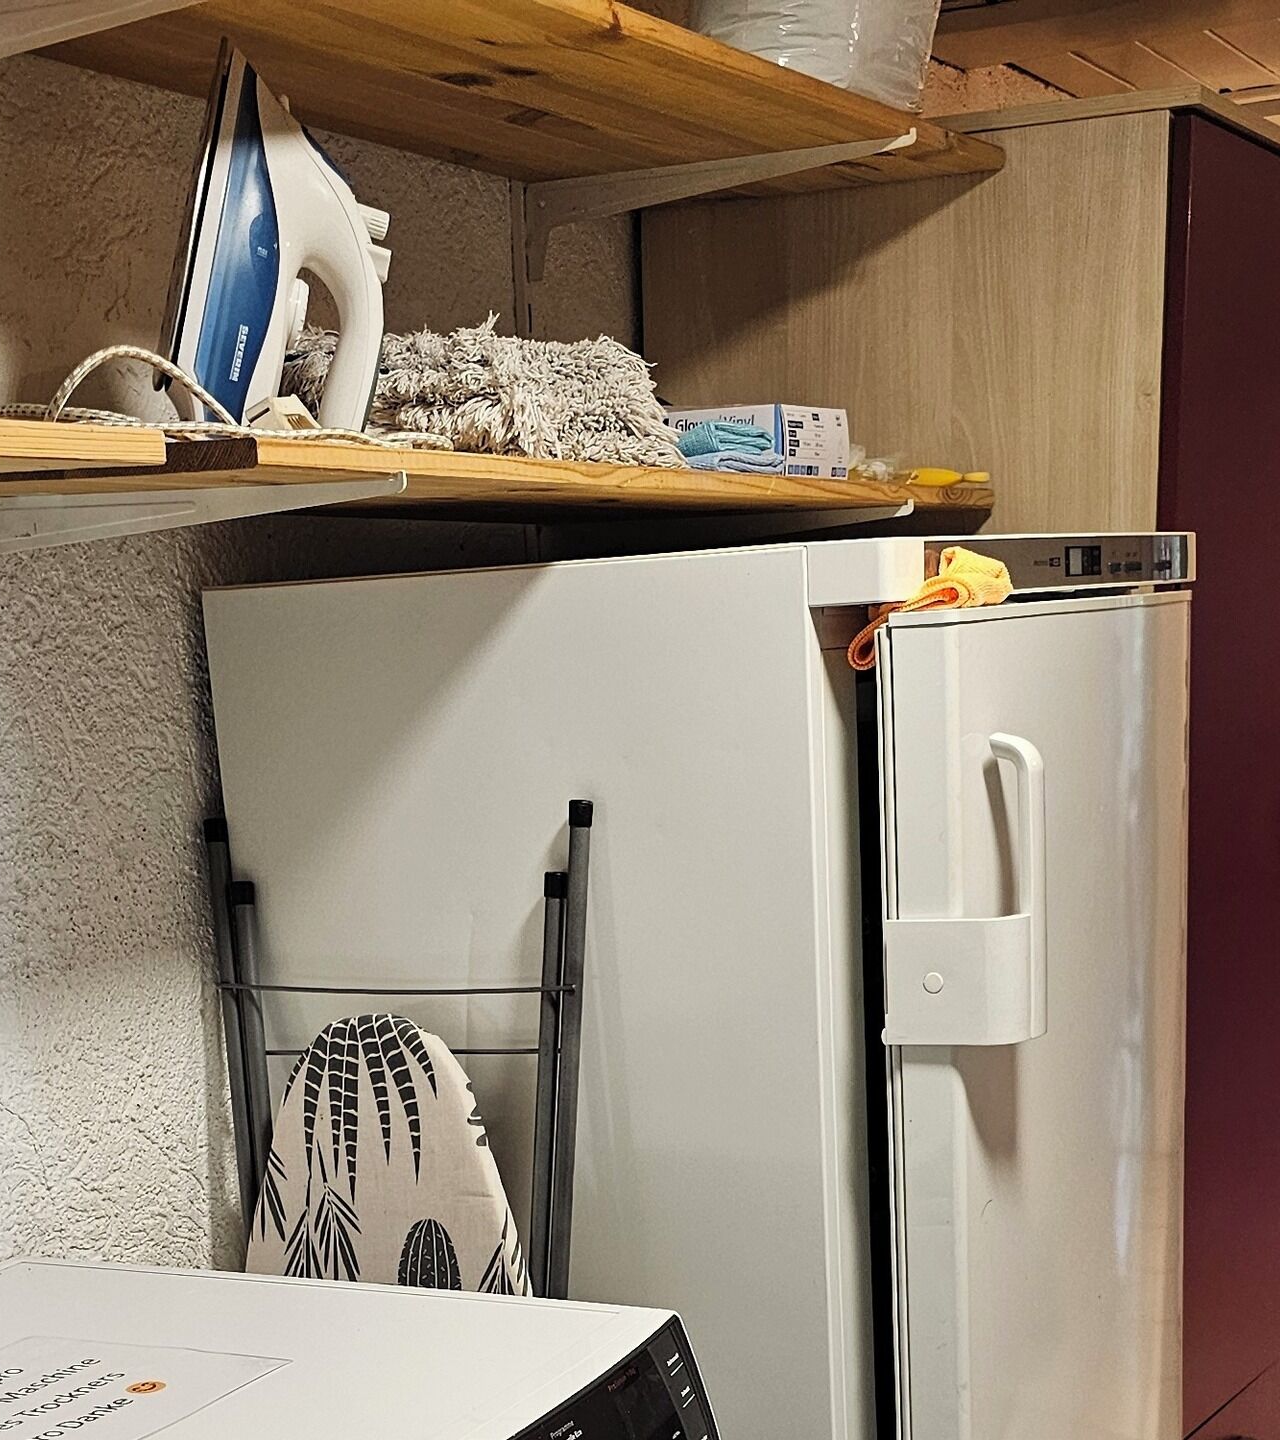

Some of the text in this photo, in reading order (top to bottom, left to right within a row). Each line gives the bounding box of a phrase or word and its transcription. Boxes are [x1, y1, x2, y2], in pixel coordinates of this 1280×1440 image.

[231, 324, 249, 382] SEVERIN
[12, 1372, 125, 1417] Trockners
[56, 1397, 134, 1429] Danke
